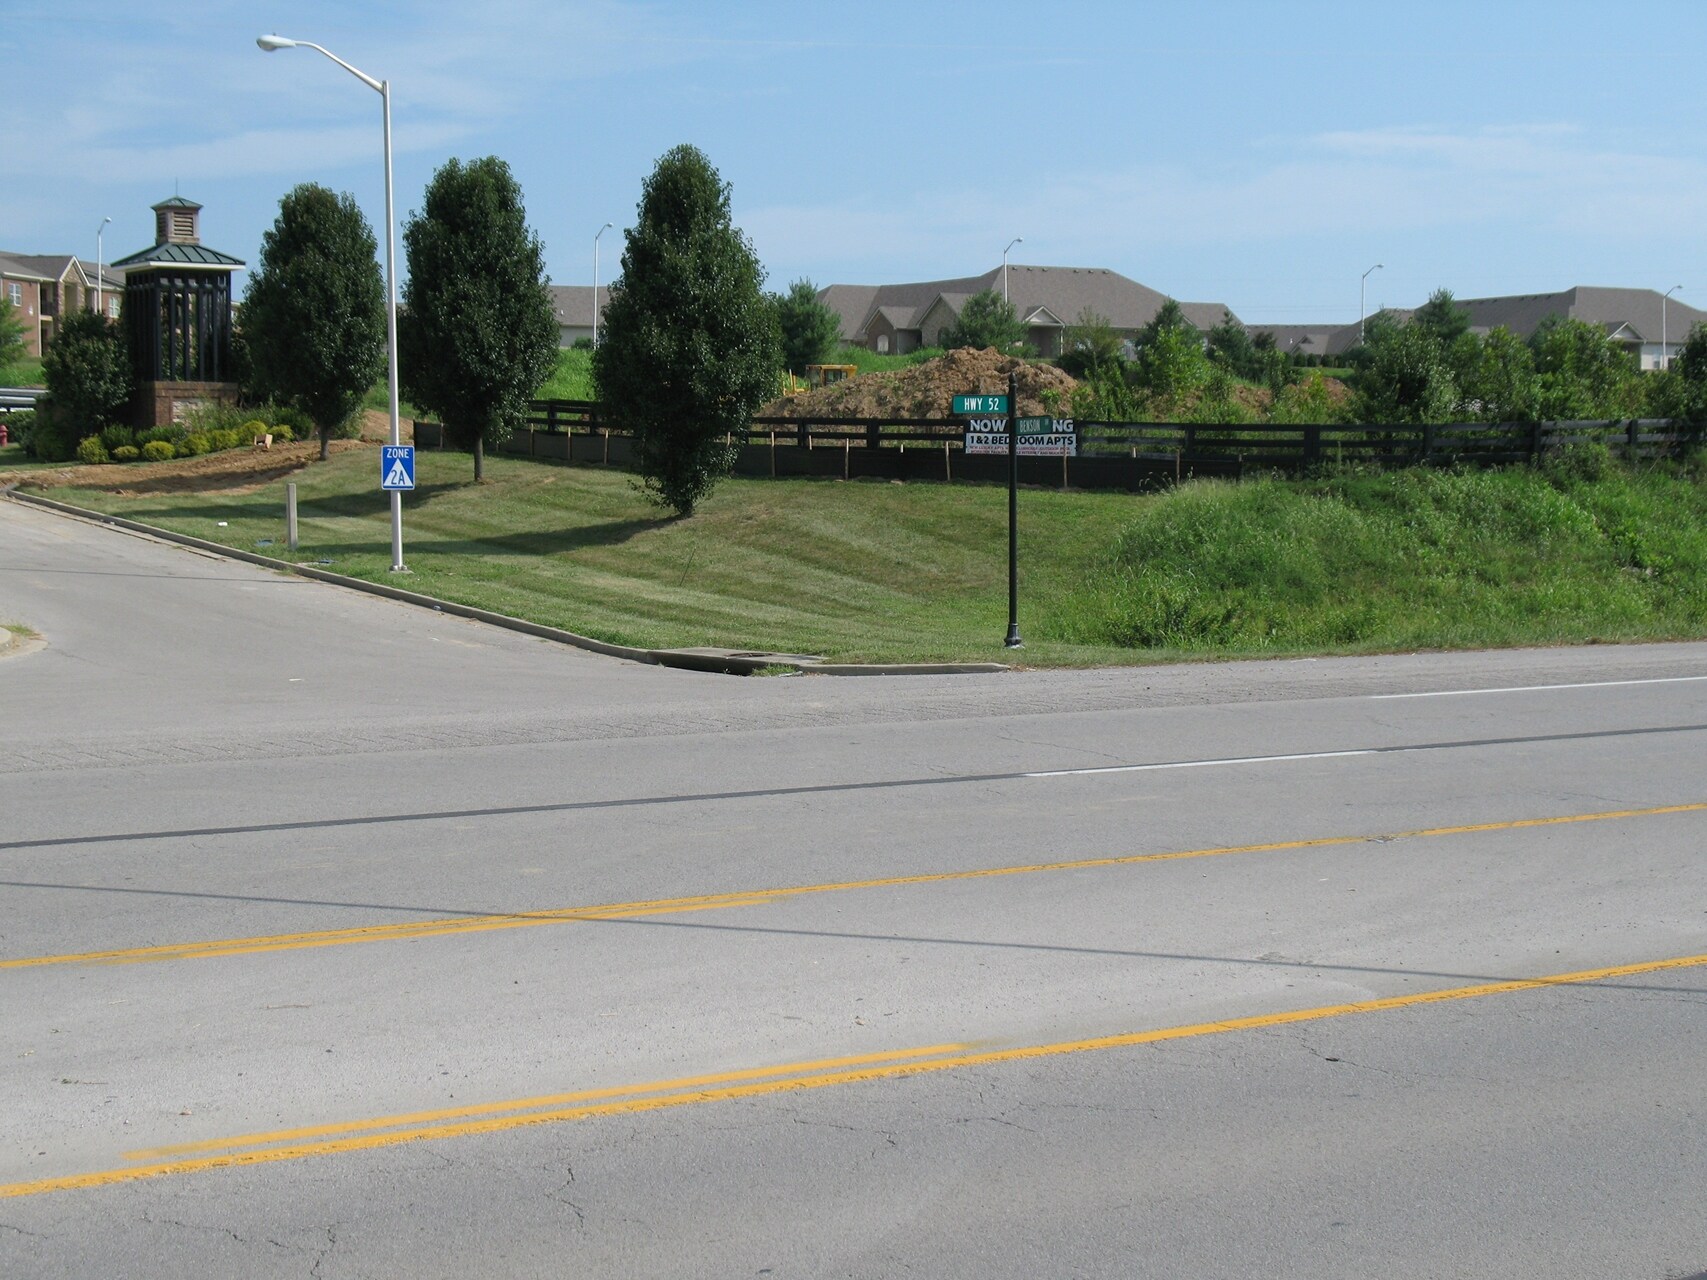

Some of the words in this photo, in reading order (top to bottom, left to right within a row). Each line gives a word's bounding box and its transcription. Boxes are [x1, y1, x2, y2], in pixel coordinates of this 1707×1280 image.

[964, 397, 983, 411] HWY
[988, 397, 999, 411] 52
[970, 419, 1007, 432] NOW
[1020, 418, 1041, 433] BENSON
[1045, 435, 1074, 445] APTS
[386, 448, 410, 459] ZONE
[390, 469, 406, 485] 2A
